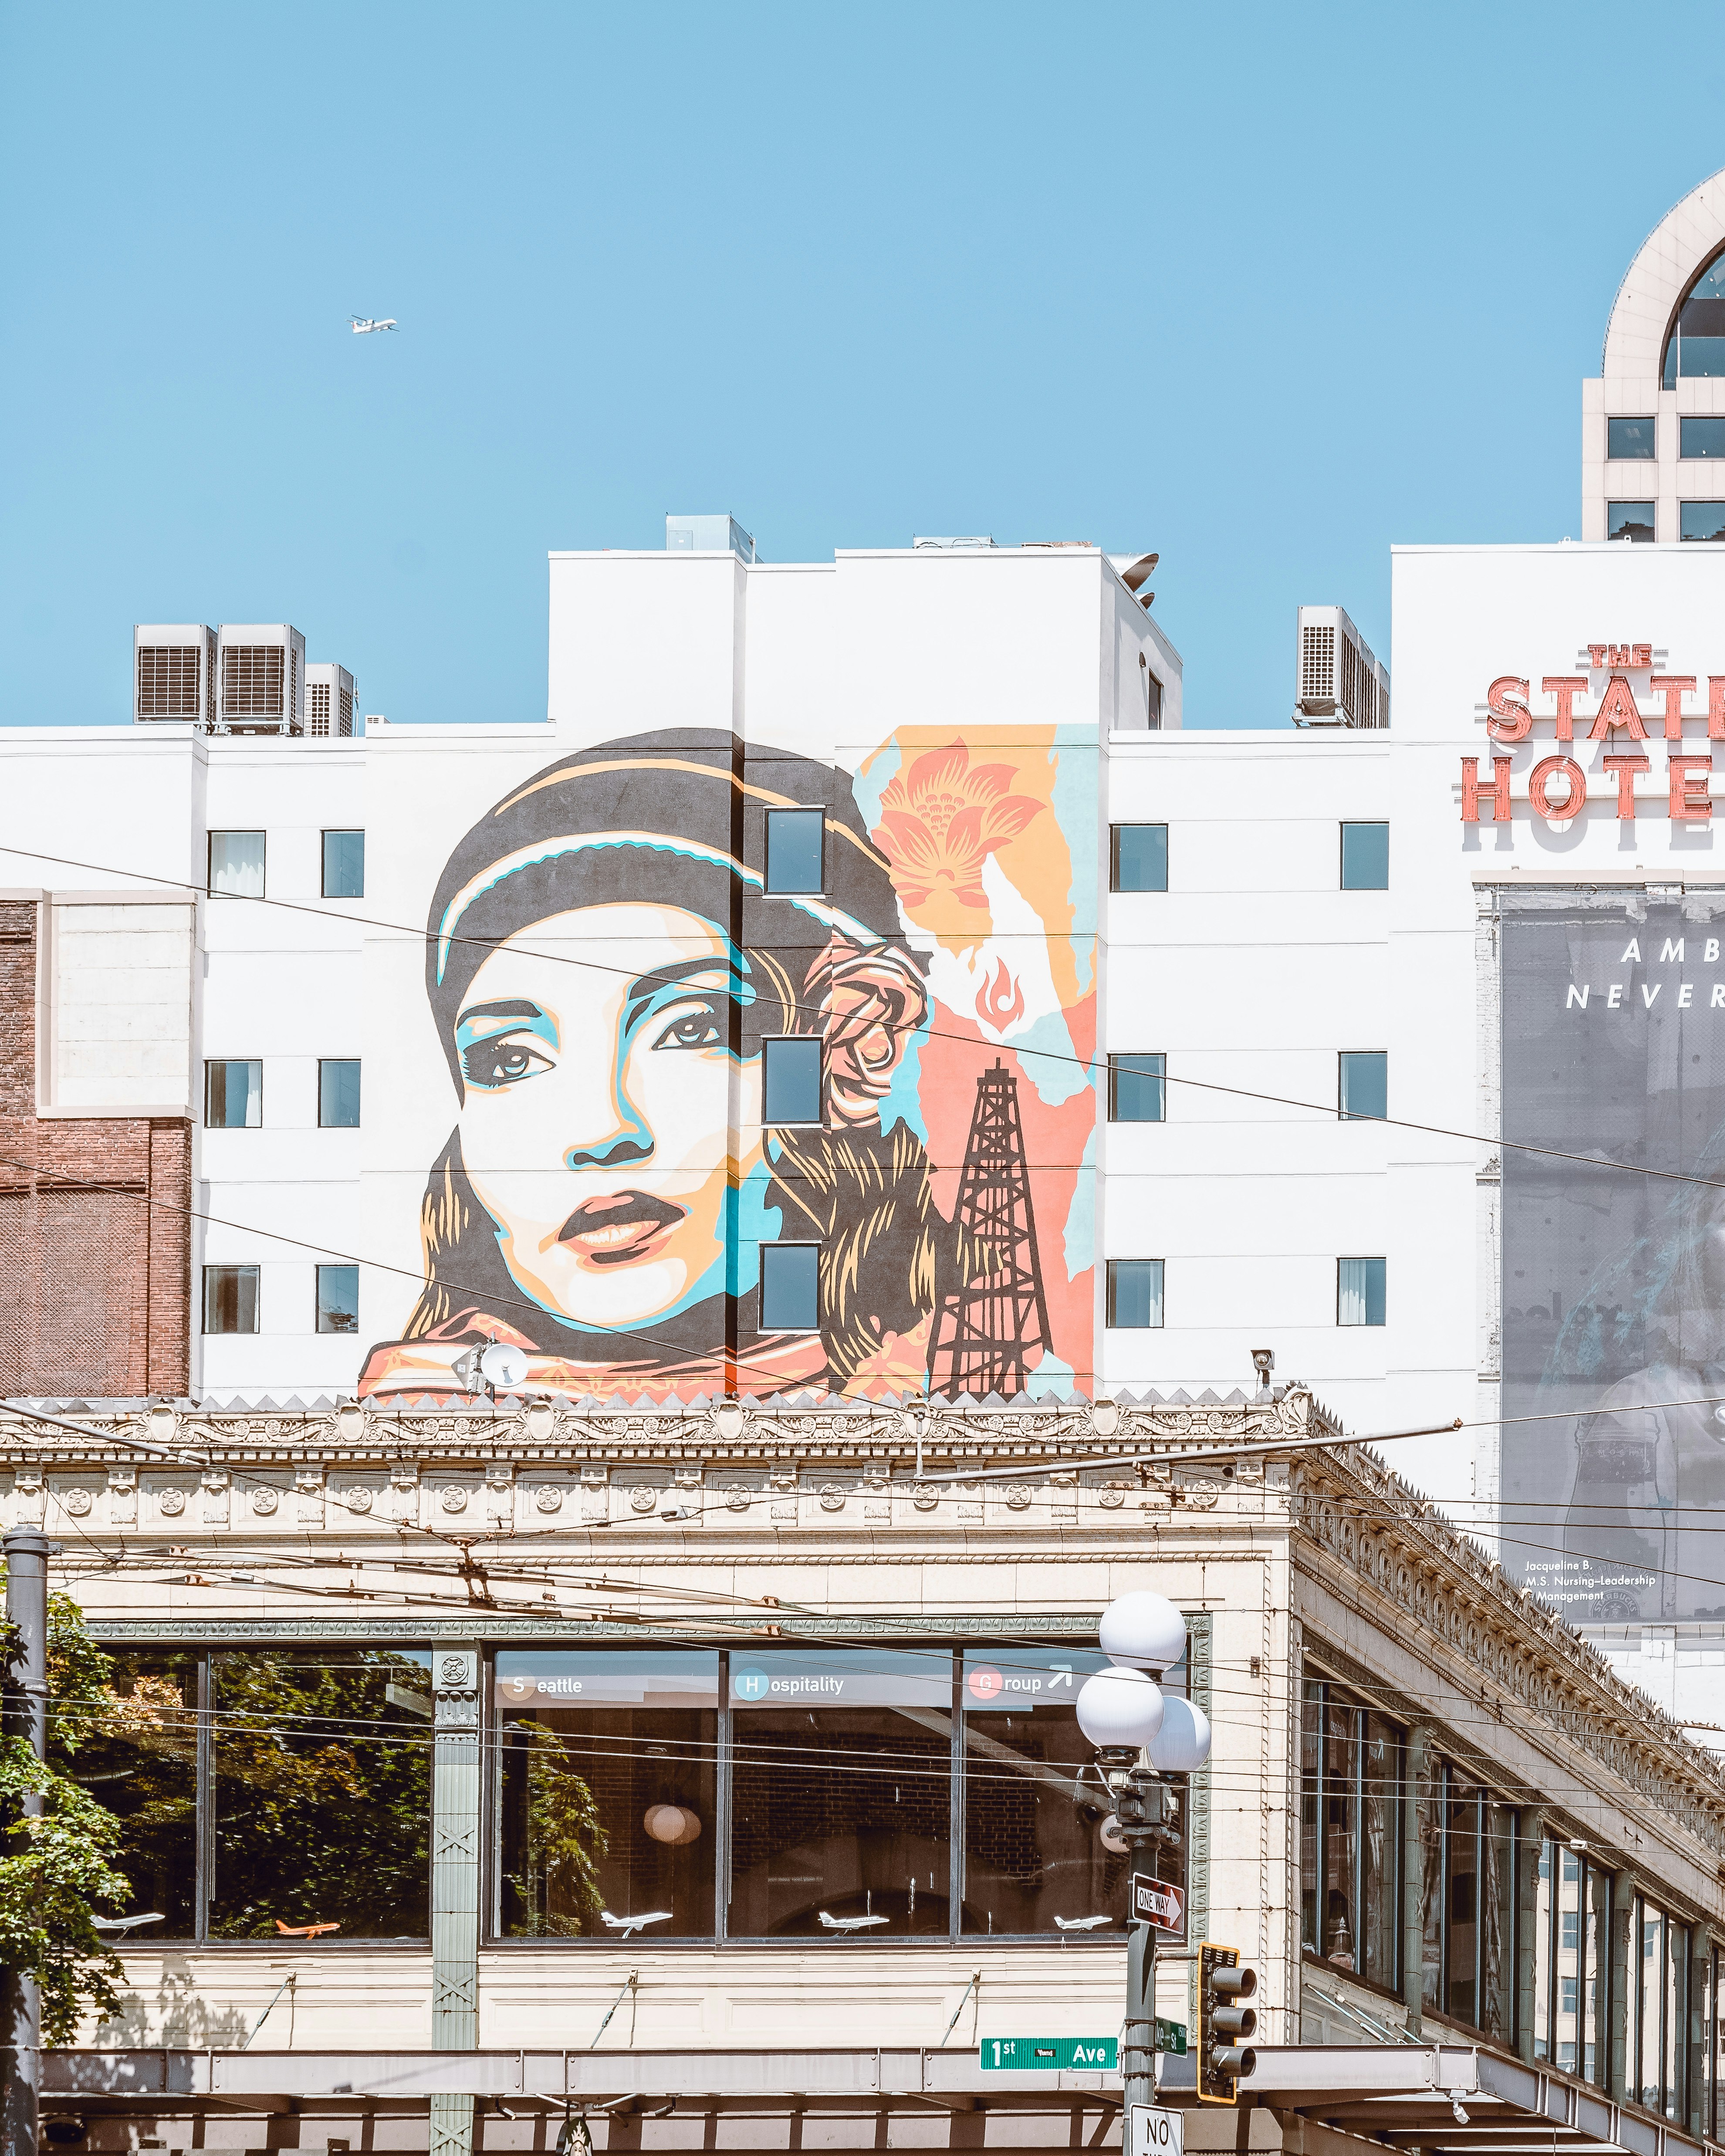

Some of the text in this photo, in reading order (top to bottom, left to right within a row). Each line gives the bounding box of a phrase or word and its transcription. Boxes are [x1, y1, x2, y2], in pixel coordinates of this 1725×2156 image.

[1588, 644, 1652, 668] THE
[1460, 755, 1712, 821] HOTE
[1620, 937, 1720, 963] AMB
[1566, 984, 1725, 1009] NEVER
[1525, 1560, 1593, 1573] Jacqueline B.
[1526, 1576, 1550, 1586] M.S.
[1537, 1591, 1604, 1603] Management
[1594, 1592, 1637, 1612] STARBUCKS
[1139, 1889, 1170, 1915] ONE WAY
[1171, 2032, 1177, 2050] St
[992, 2041, 1106, 2066] 1st Ave
[1147, 2117, 1169, 2146] NO
